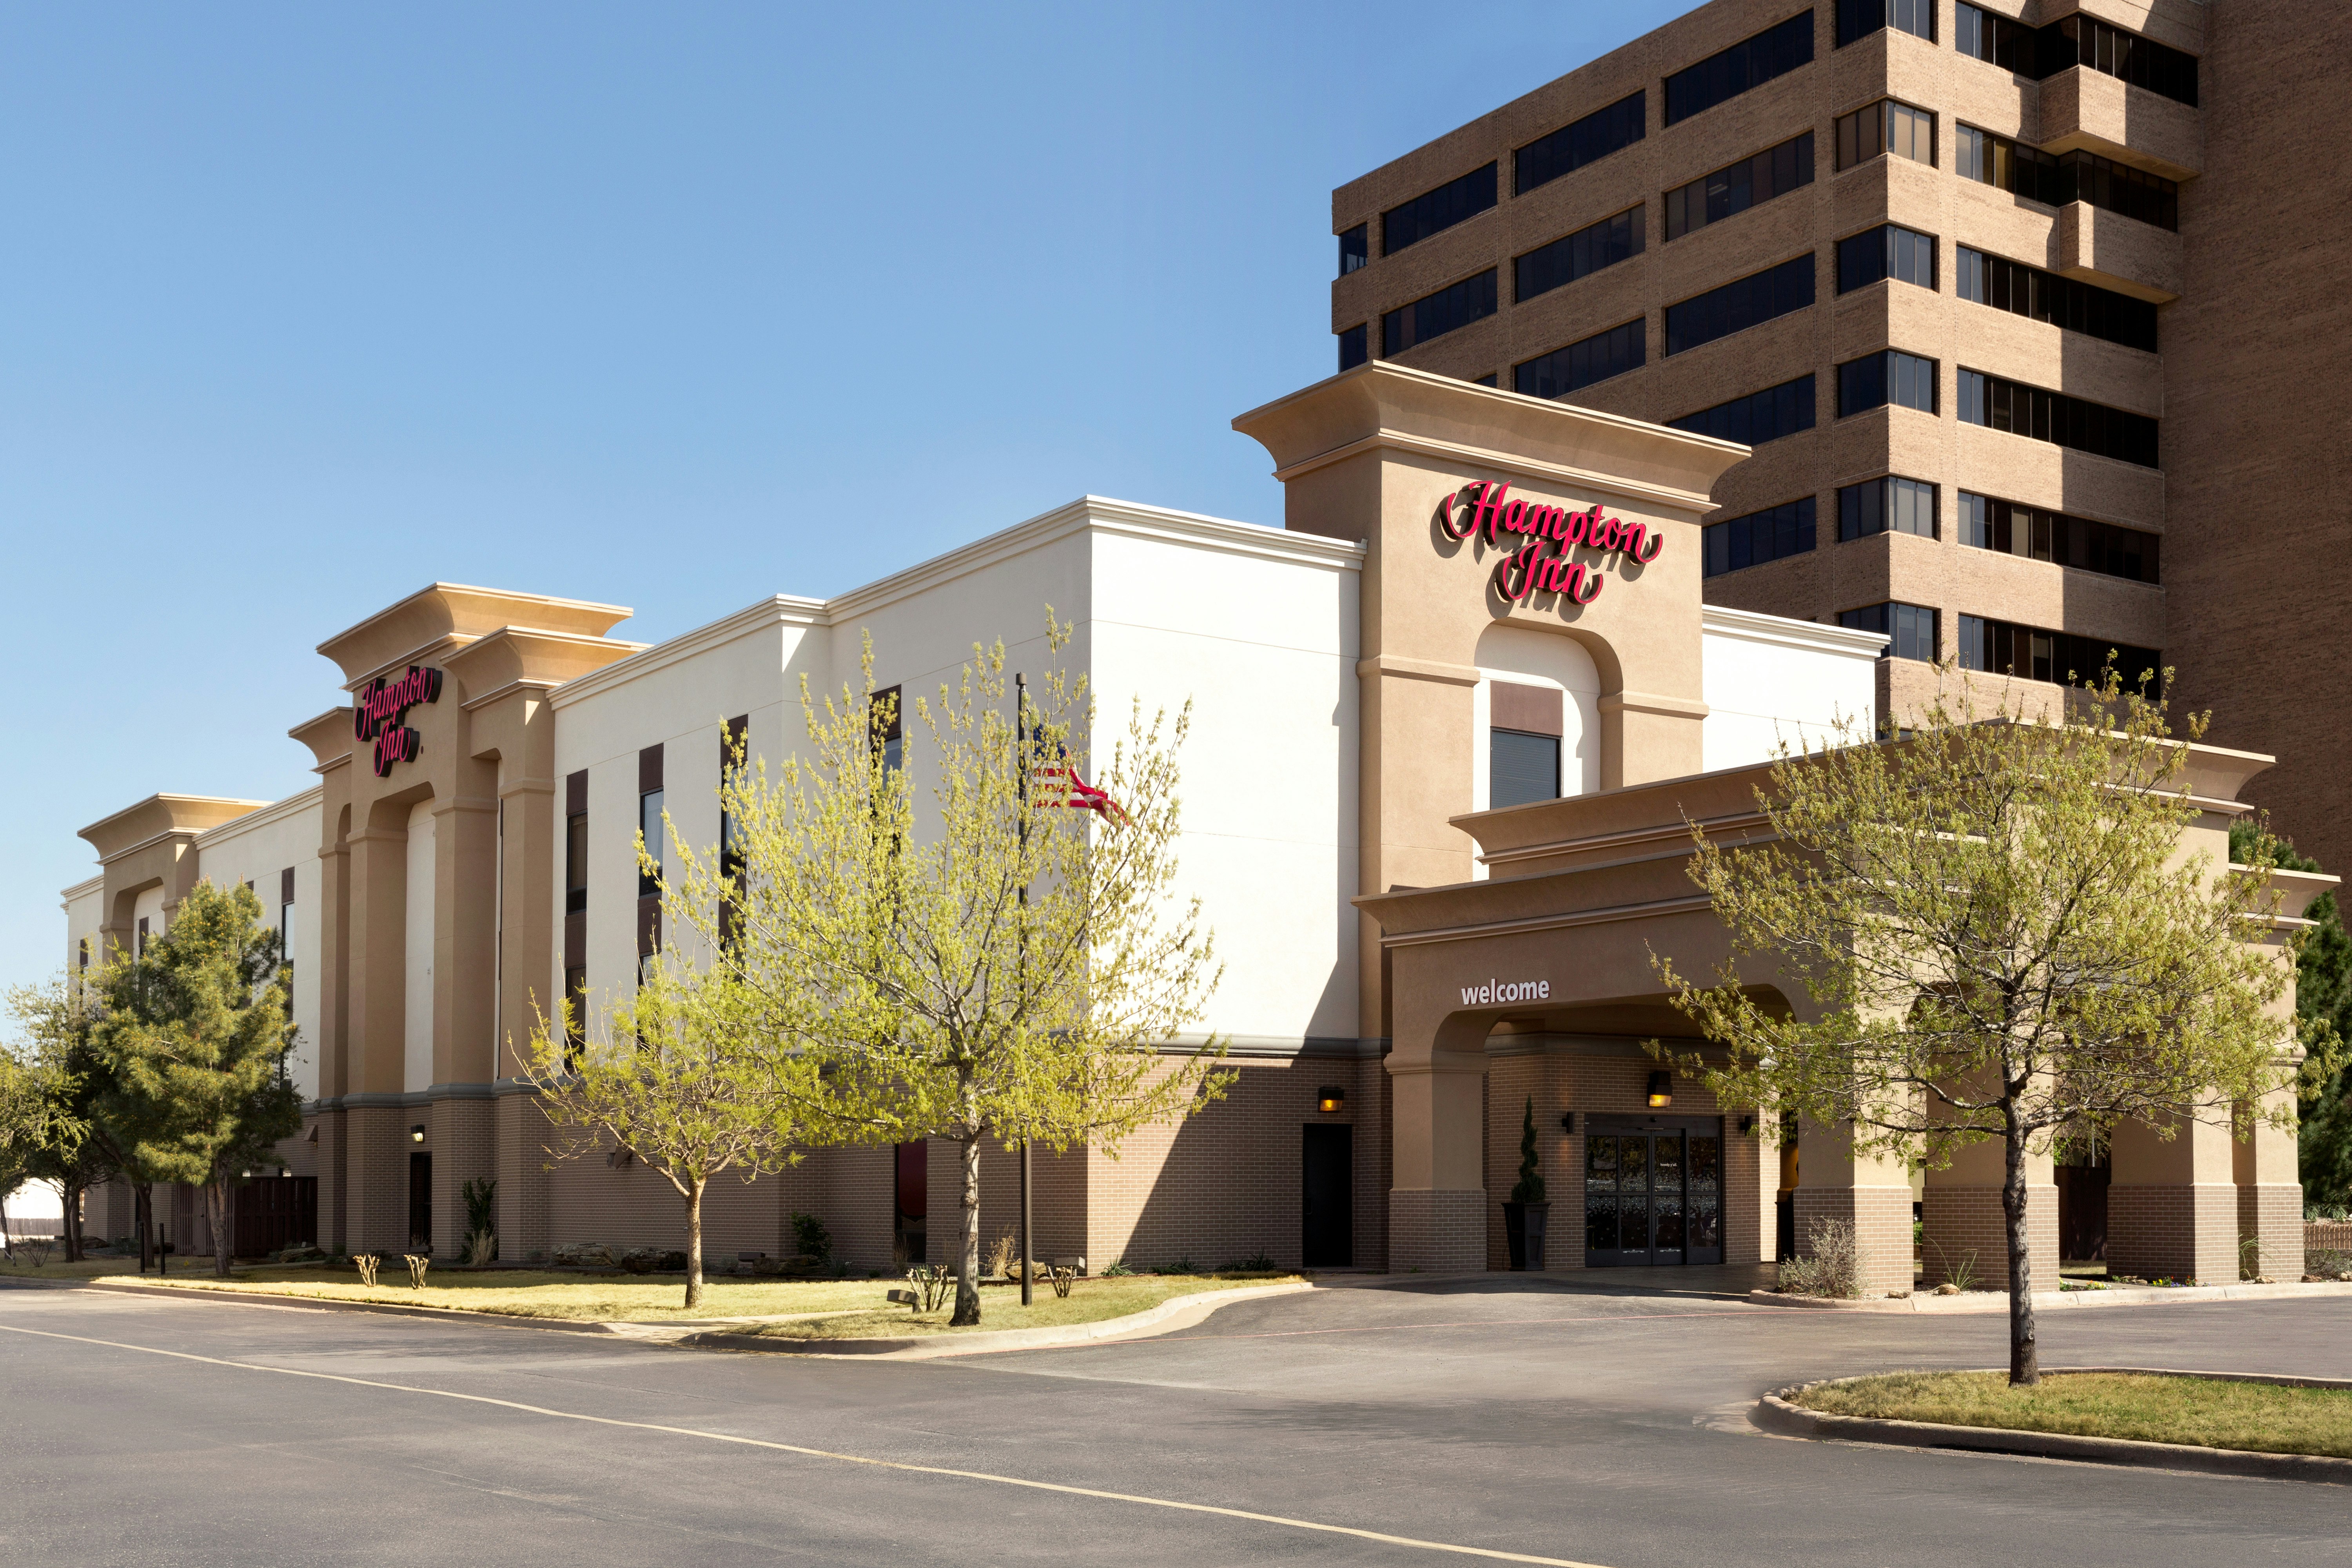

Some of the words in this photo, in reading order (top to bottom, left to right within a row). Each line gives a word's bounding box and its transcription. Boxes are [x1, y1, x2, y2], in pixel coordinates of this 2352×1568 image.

[1446, 479, 1663, 563] Hampton
[1502, 541, 1604, 604] Inn
[354, 665, 433, 742] Hampton
[374, 720, 410, 777] Inn
[1461, 978, 1550, 1005] welcome
